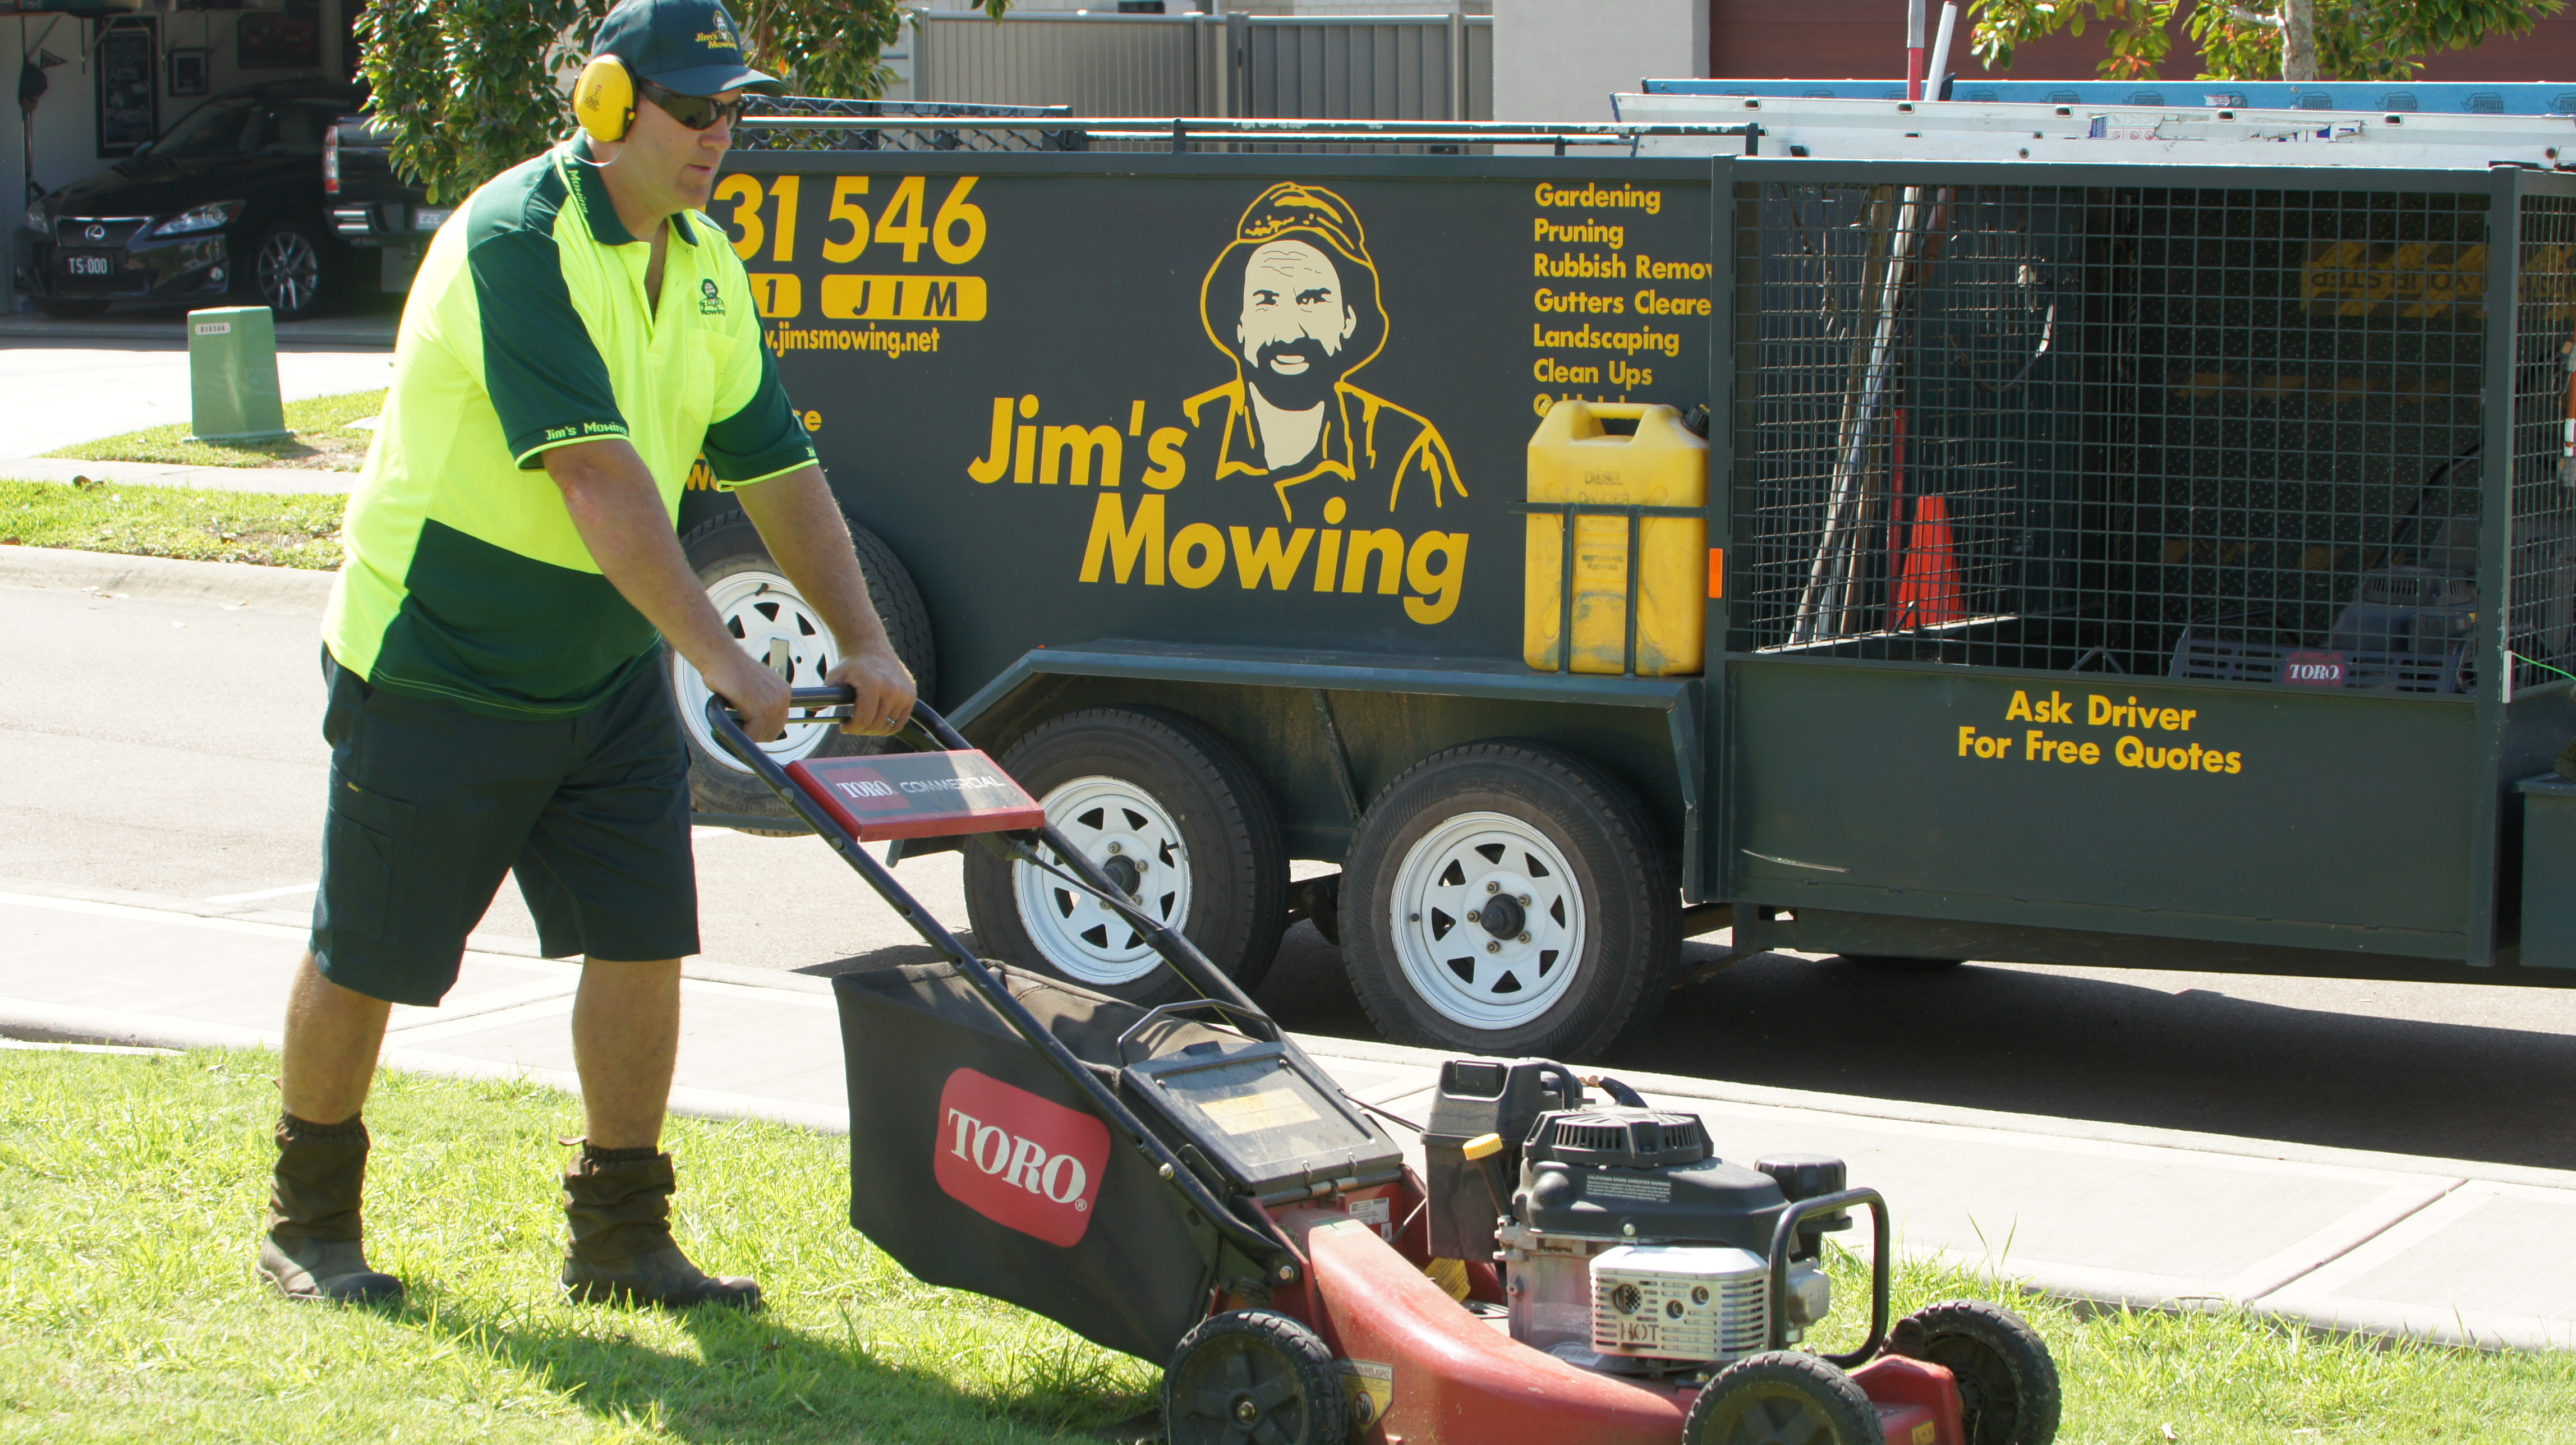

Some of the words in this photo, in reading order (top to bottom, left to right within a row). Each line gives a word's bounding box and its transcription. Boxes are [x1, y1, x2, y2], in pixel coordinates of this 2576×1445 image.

[695, 32, 718, 42] Jim's
[2472, 99, 2504, 111] RHINO
[1535, 182, 1661, 214] Gardening
[699, 173, 800, 262] 31
[822, 176, 987, 264] 546
[1534, 218, 1624, 250] Pruning
[1534, 253, 1627, 278] Rubbish
[2311, 267, 2382, 289] STEP
[1534, 288, 1625, 314] Gutters
[1635, 289, 1712, 316] Cleare
[1534, 323, 1680, 357] Landscaping
[1534, 357, 1599, 383] Clean
[1609, 360, 1653, 391] Ups
[545, 426, 577, 440] Jim's
[583, 422, 628, 436] Mowing
[968, 394, 1188, 490] Jim's
[1585, 471, 1624, 485] DIESEL
[1578, 491, 1630, 504] DANGER
[1079, 491, 1470, 625] Mowing
[2289, 664, 2340, 680] TORO
[2005, 690, 2073, 725] Ask
[2088, 694, 2197, 731] Driver
[1958, 726, 2012, 760] For
[2026, 729, 2101, 765] Free
[2115, 735, 2242, 775] Quotes
[836, 780, 894, 798] TORO
[900, 775, 1005, 793] COMMERCIAL
[947, 1107, 1086, 1204] TORO
[1620, 1322, 1660, 1342] HOT
